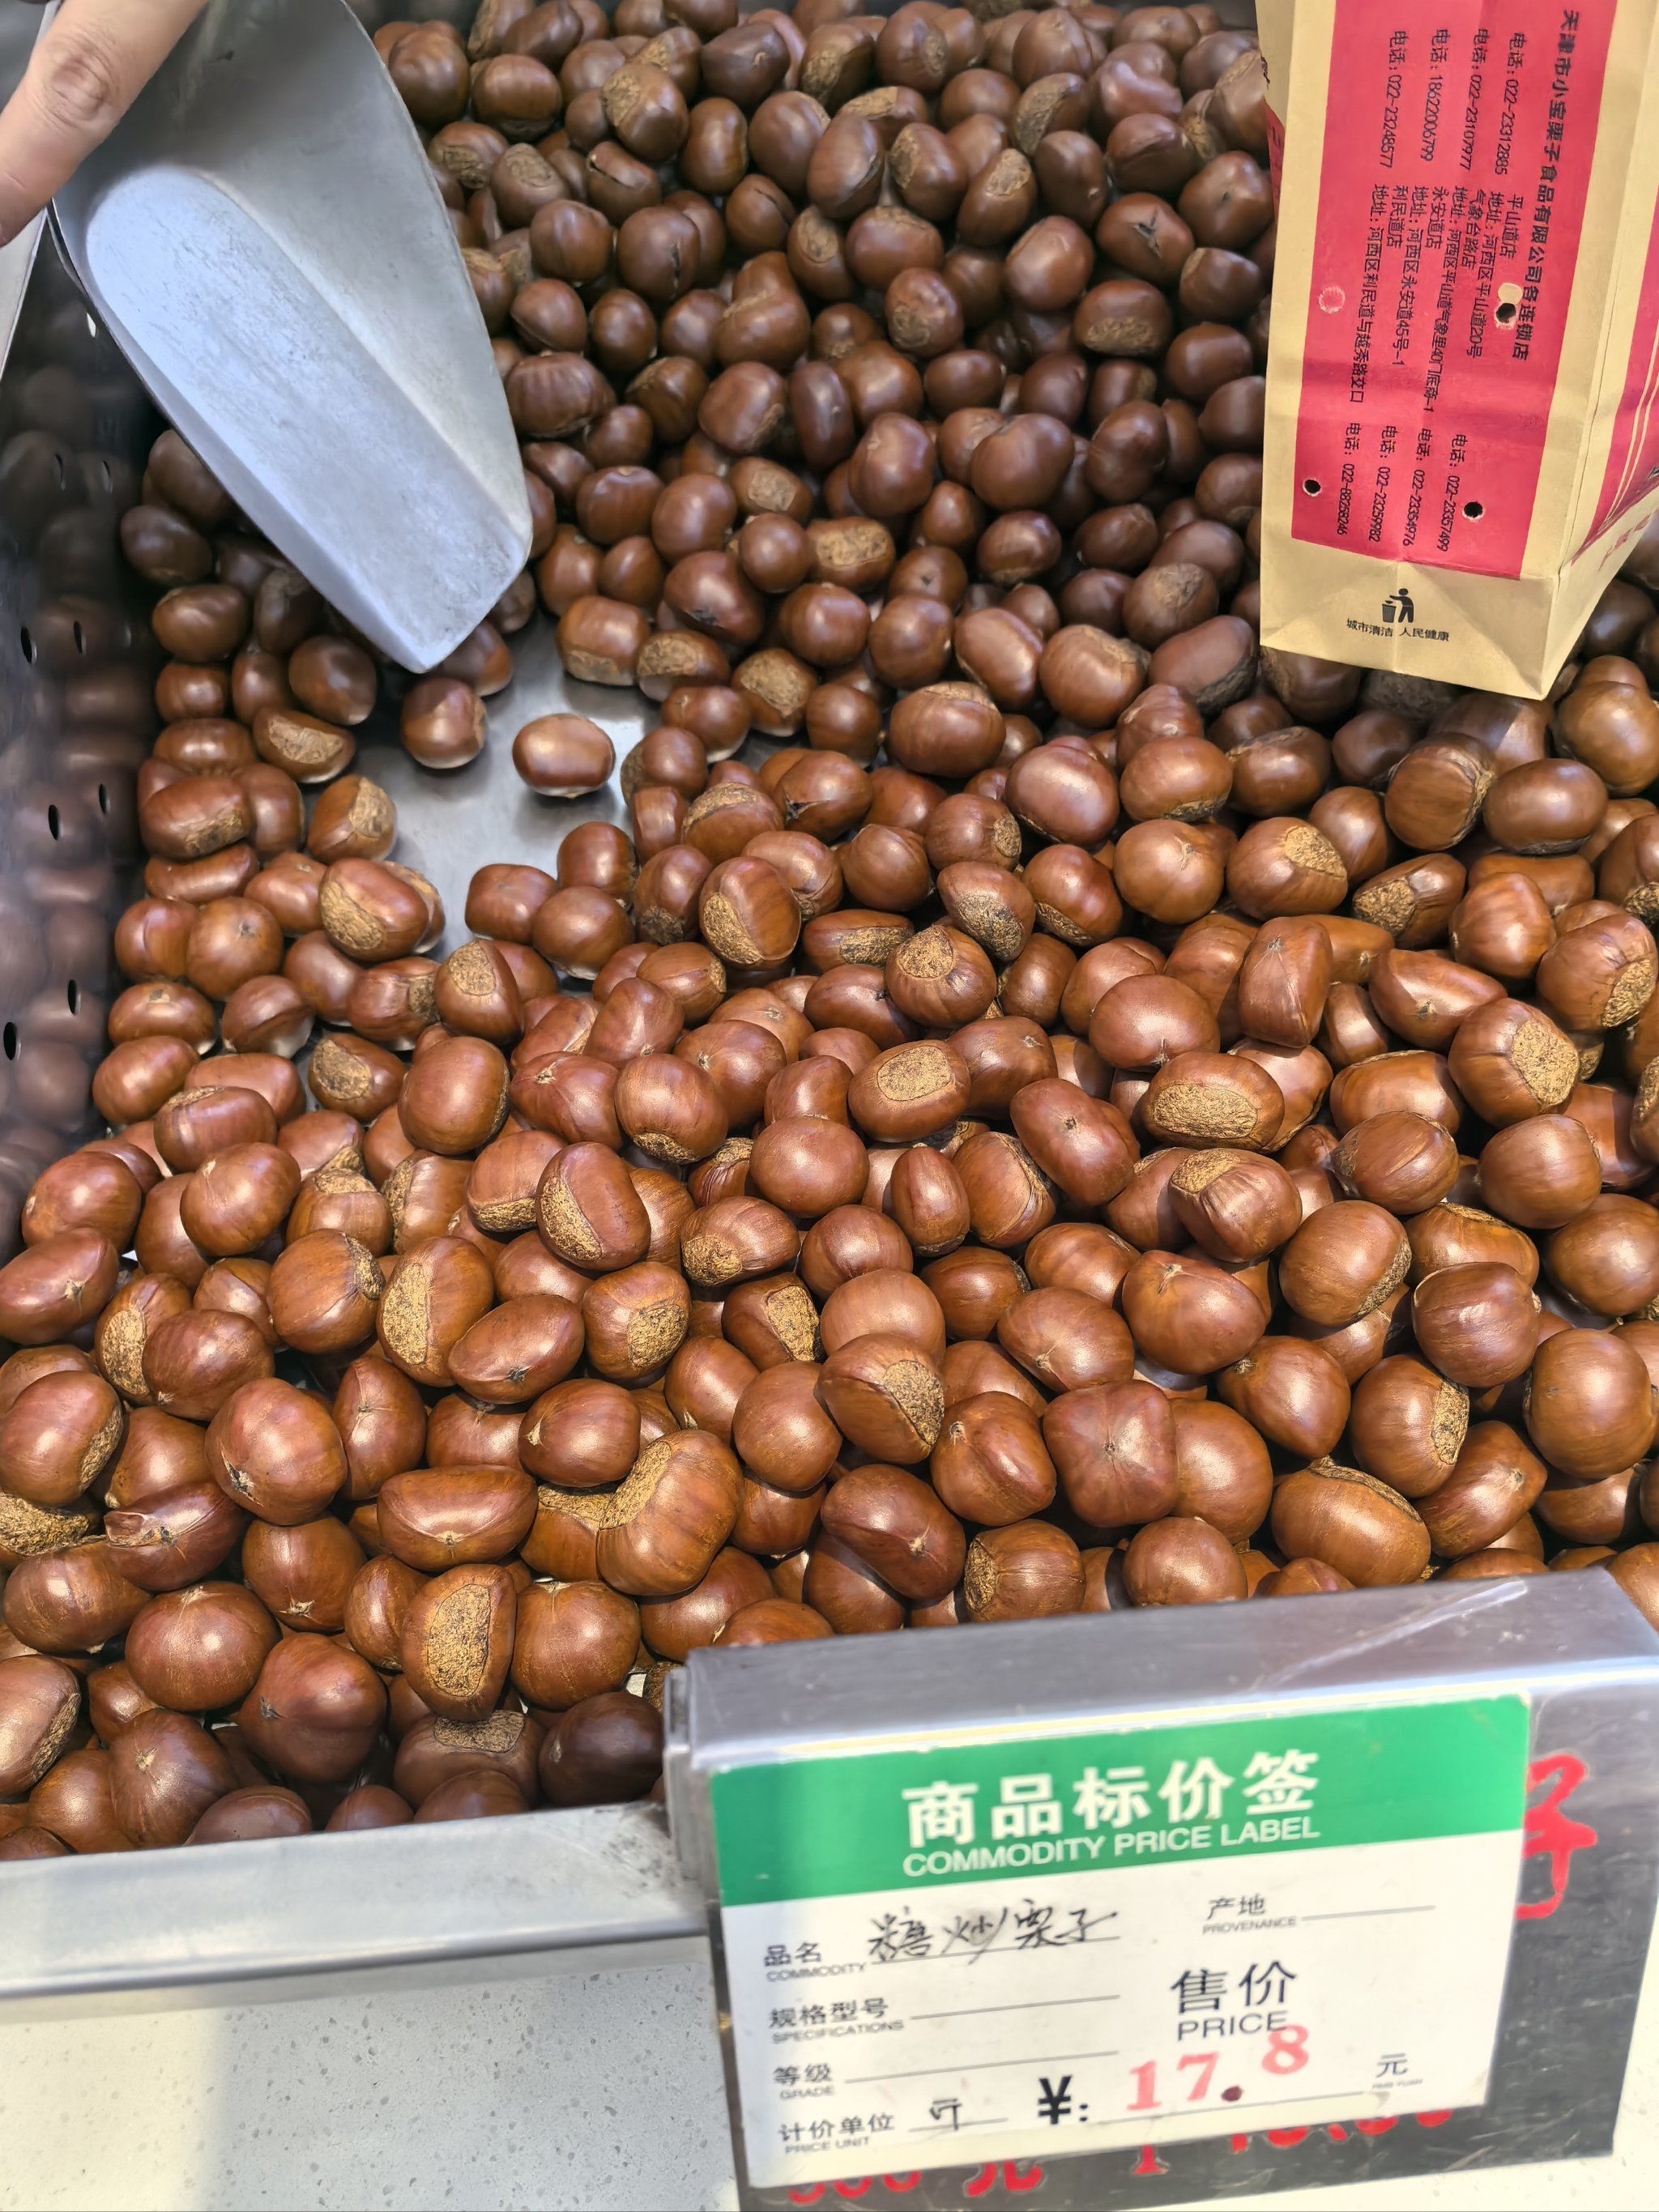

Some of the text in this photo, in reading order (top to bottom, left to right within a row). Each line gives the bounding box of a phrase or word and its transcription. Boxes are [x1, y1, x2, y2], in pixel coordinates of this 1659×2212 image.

[1385, 184, 1408, 248] 利民道店
[1425, 185, 1446, 249] 永安道店
[1460, 188, 1486, 271] 气象台路店
[1499, 194, 1524, 258] 平山道店
[1346, 617, 1449, 641] 城市清洁 人民健康
[901, 1748, 1320, 1848] 商品标价签
[902, 1816, 1321, 1877] COMMODITY PRICE LABEL
[1207, 1893, 1266, 1920] 产地
[764, 1941, 821, 1967] 品名
[1170, 1960, 1298, 2016] 售价
[769, 1997, 889, 2029] 规格型号
[1177, 2010, 1289, 2040] PRICE
[773, 2063, 833, 2086] 等级
[1375, 2052, 1409, 2078] 元
[778, 2112, 895, 2143] 计价单位
